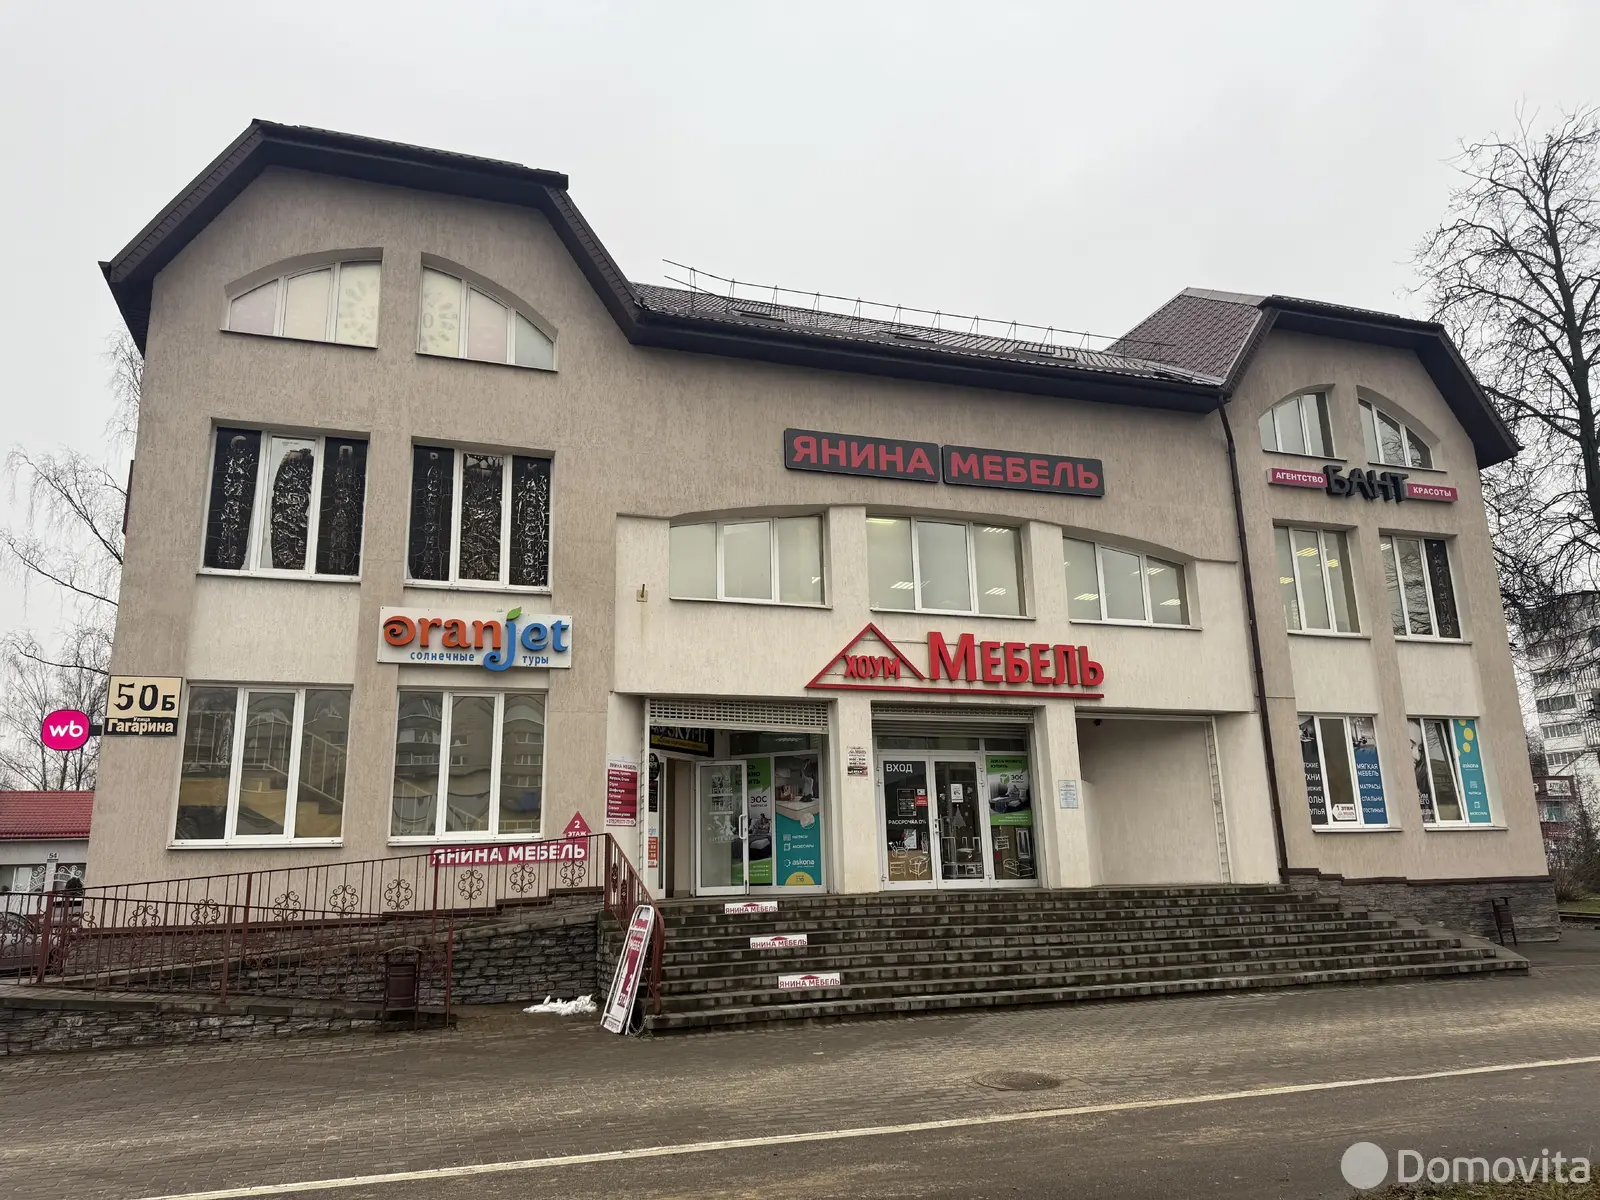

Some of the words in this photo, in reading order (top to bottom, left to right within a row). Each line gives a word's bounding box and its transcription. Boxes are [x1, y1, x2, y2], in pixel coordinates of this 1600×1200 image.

[792, 435, 935, 476] ЯНИНА
[950, 452, 1099, 489] МЕБЕЛЬ
[1275, 471, 1324, 485] АГЕНТСТВО
[1325, 464, 1409, 502] БАНТ
[1412, 486, 1452, 498] КРАСОТЫ
[410, 651, 475, 662] солнечные
[522, 654, 549, 667] туры
[843, 652, 901, 680] ХОУМ
[926, 631, 1105, 687] МЕБЕЛЬ
[49, 720, 84, 738] wb
[107, 718, 174, 735] Гагарина
[886, 763, 913, 773] ВХОД
[750, 795, 767, 803] ЭОС
[574, 820, 581, 828] 2
[432, 848, 502, 864] ЯНИНА
[508, 844, 585, 861] МЕБЕЛЬ
[751, 941, 776, 949] ЯНИНА
[778, 939, 807, 947] МЕБЕЛЬ
[779, 980, 806, 988] ЯНИНА
